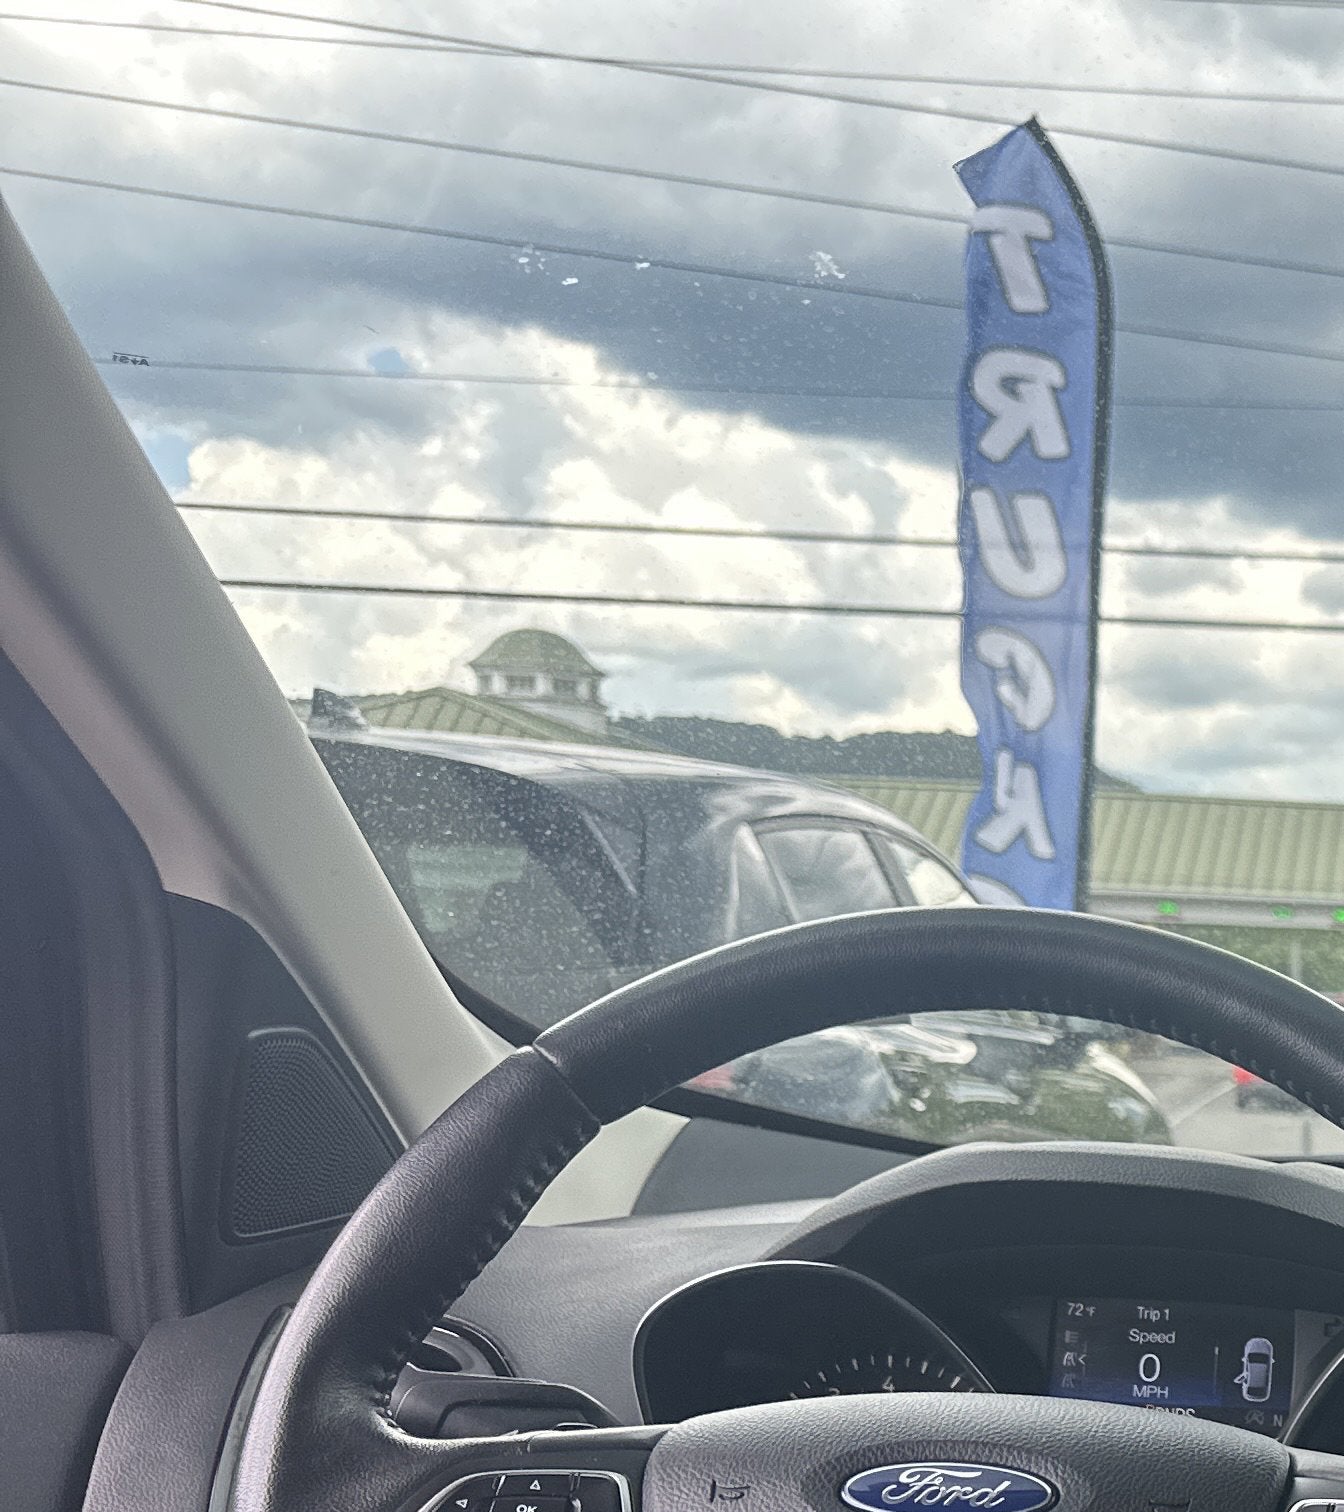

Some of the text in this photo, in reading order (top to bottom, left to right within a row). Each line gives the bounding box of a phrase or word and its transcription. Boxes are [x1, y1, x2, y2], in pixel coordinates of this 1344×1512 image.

[1137, 1305, 1170, 1322] Trip 1
[1129, 1328, 1176, 1344] Speed
[1138, 1353, 1161, 1382] 0
[1132, 1384, 1169, 1399] MPH
[1273, 1414, 1283, 1427] N
[881, 1467, 1012, 1509] Ford
